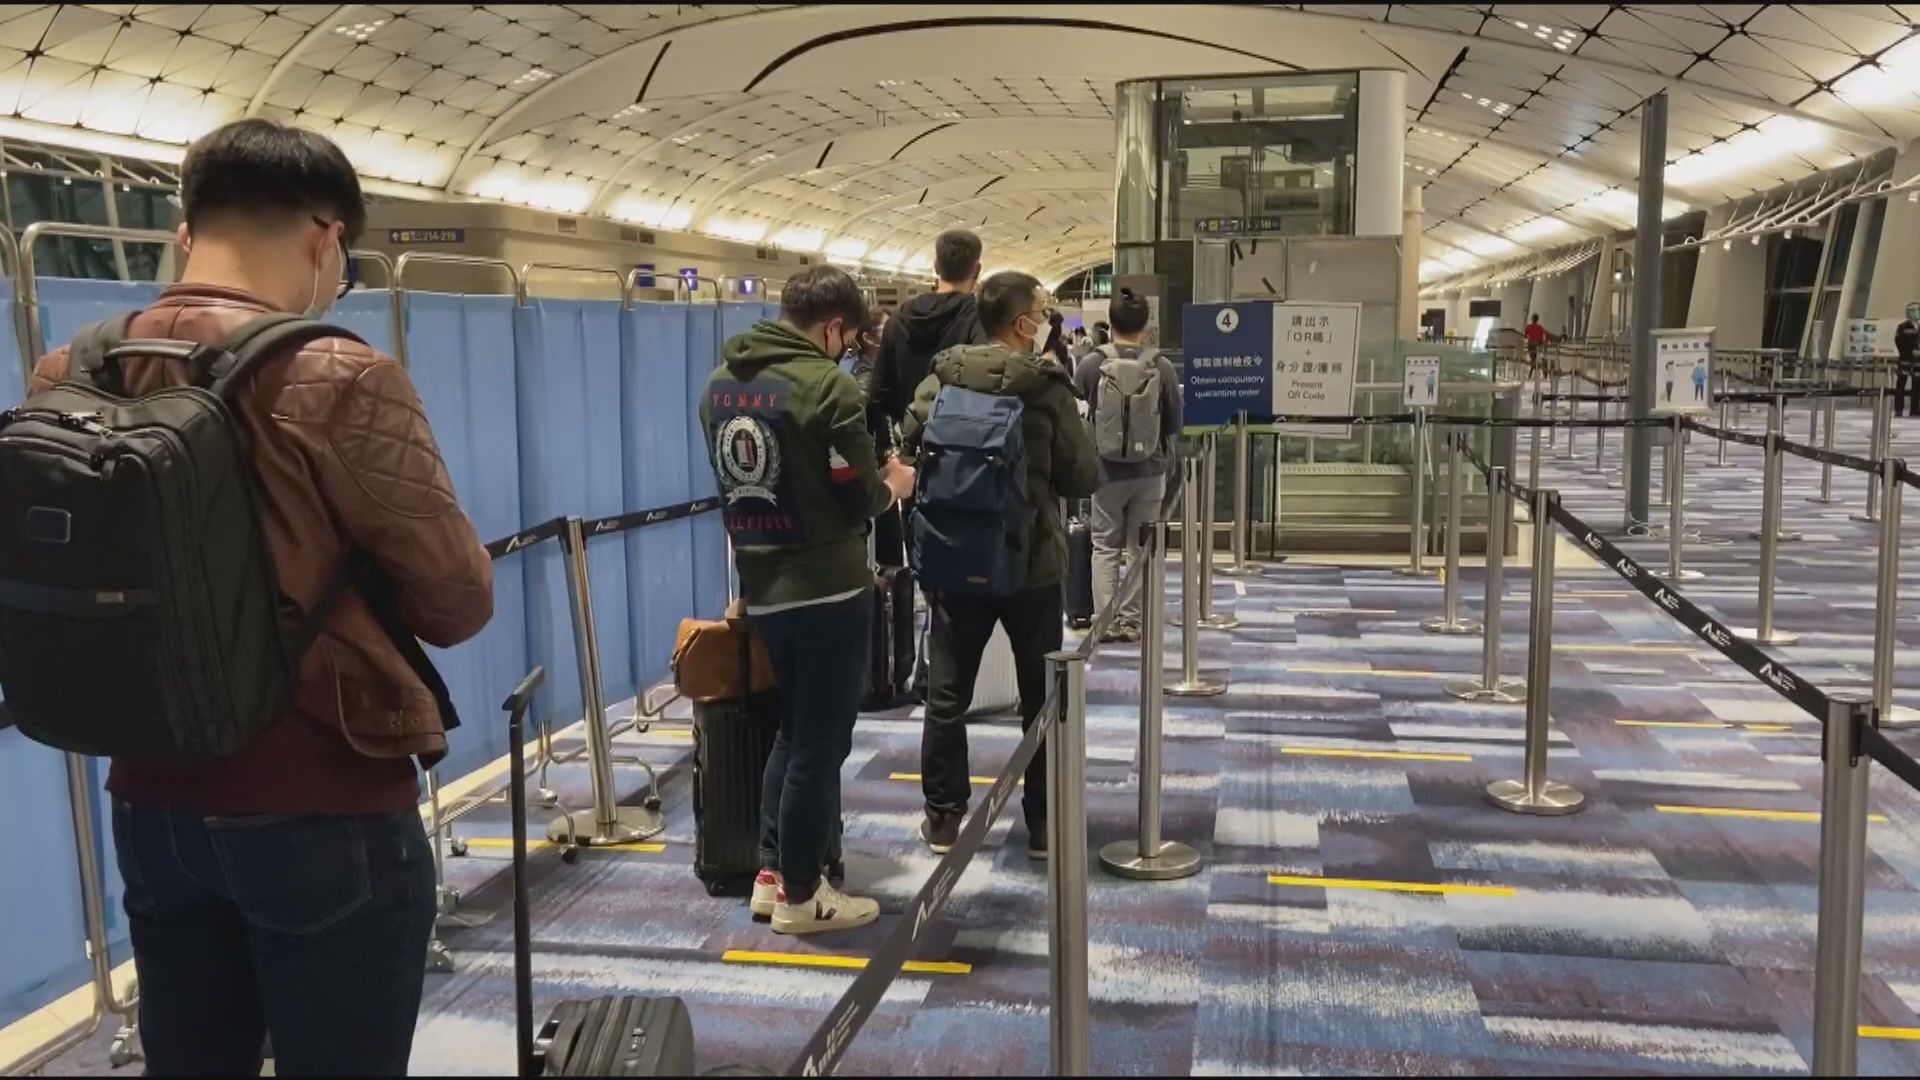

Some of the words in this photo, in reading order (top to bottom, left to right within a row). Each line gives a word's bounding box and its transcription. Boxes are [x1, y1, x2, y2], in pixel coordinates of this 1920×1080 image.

[1221, 312, 1231, 328] 4
[1190, 376, 1217, 385] Obtain
[1218, 376, 1265, 385] compulsory
[1292, 380, 1323, 389] Present
[1195, 388, 1237, 399] quarantine
[1238, 387, 1260, 397] order
[1287, 390, 1301, 399] QR
[1303, 391, 1325, 400] Code
[713, 394, 777, 408] TOMMY
